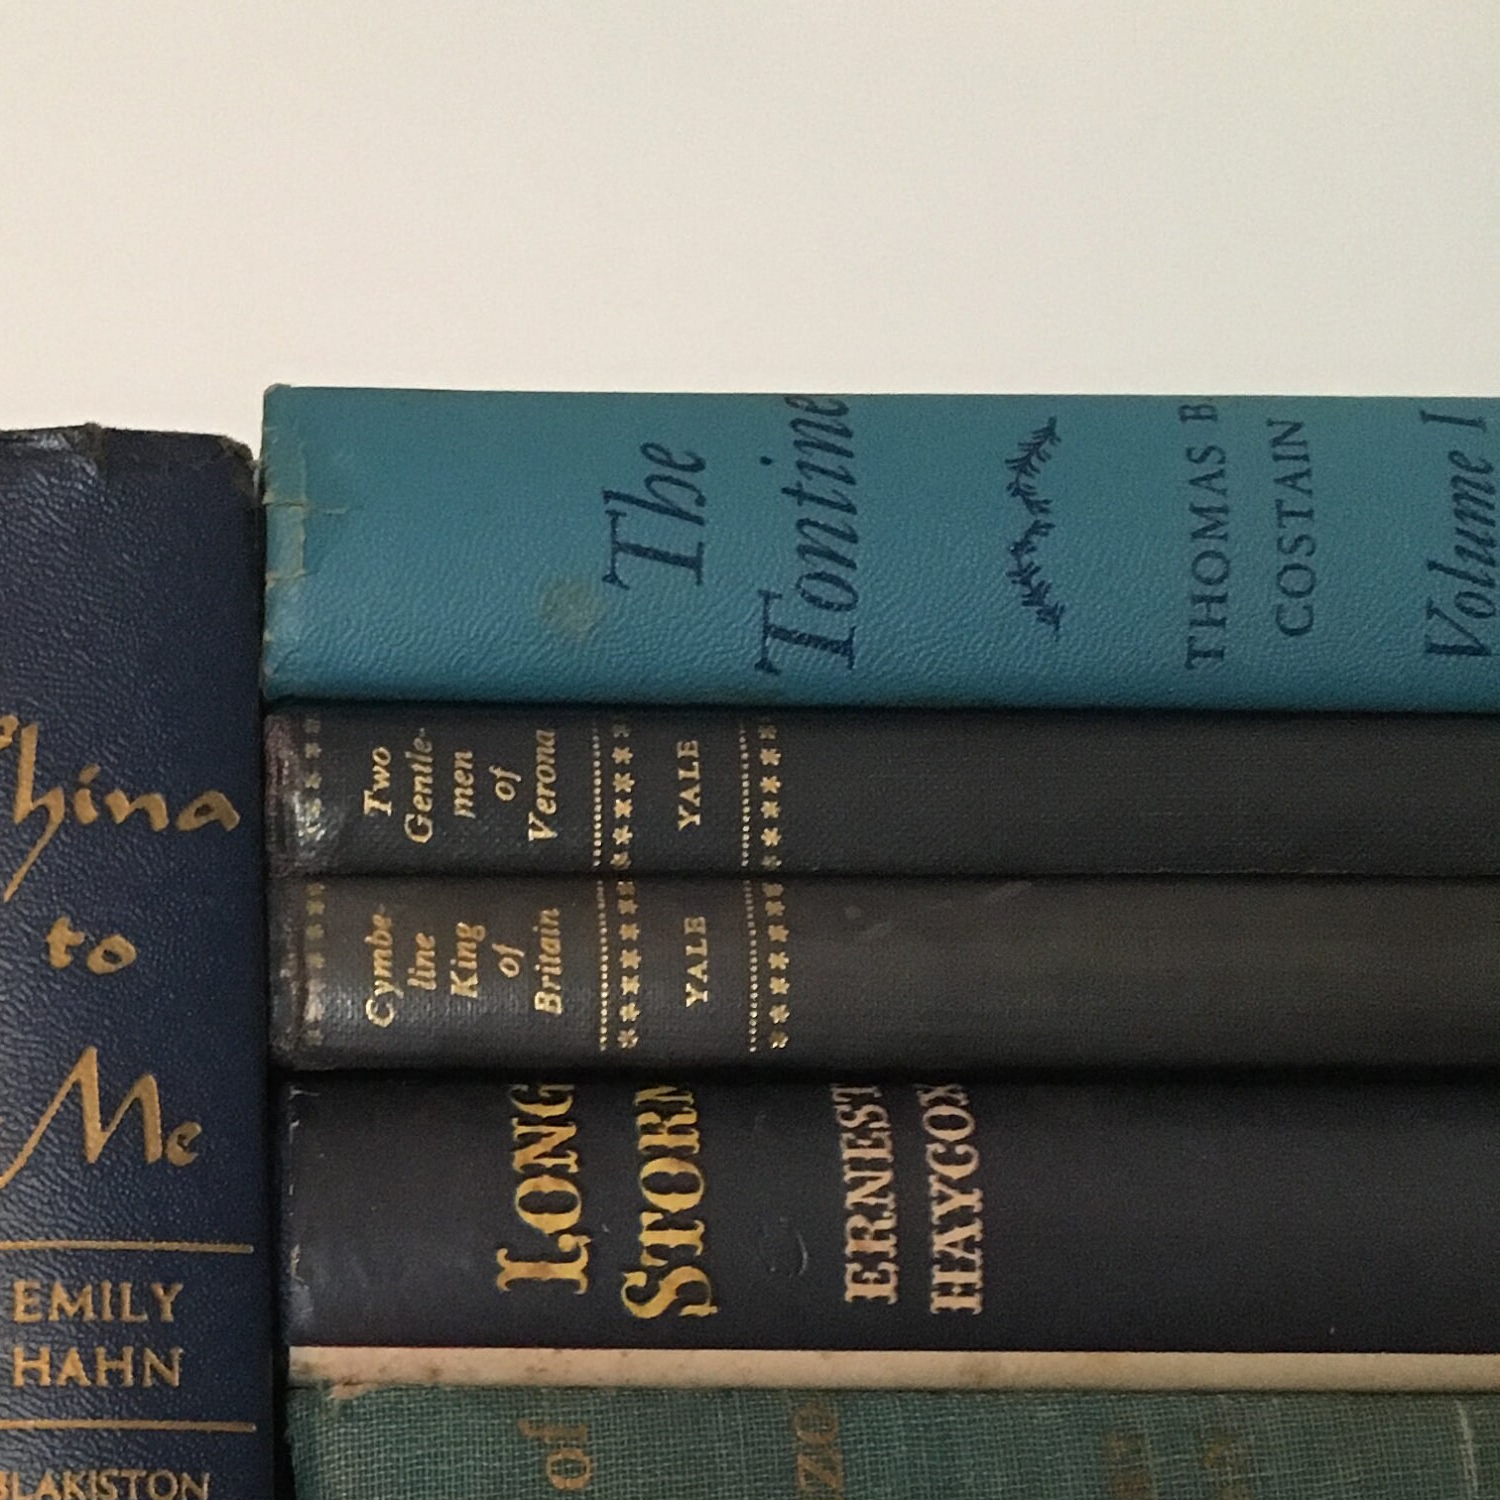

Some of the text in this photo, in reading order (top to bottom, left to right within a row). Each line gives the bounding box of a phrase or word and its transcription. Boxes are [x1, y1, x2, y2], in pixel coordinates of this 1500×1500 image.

[602, 441, 706, 590] The
[754, 395, 860, 676] Tontine
[1184, 445, 1231, 671] THOMAS
[1266, 417, 1318, 638] COSTAIN
[1422, 448, 1499, 657] Volume
[363, 745, 393, 818] Two
[403, 728, 434, 844] Gentle-
[453, 749, 476, 820] men
[488, 765, 522, 802] of
[527, 729, 558, 842] Verona
[676, 739, 701, 832] YALE
[44, 915, 138, 976] to
[406, 931, 438, 992] line
[450, 920, 487, 1000] King
[490, 942, 526, 979] of
[531, 907, 564, 1016] Britain
[683, 915, 709, 1009] YALE
[495, 1083, 591, 1295] LONG
[11, 1279, 185, 1326] EMILY
[12, 1345, 185, 1390] HAHN
[517, 1417, 596, 1493] of
